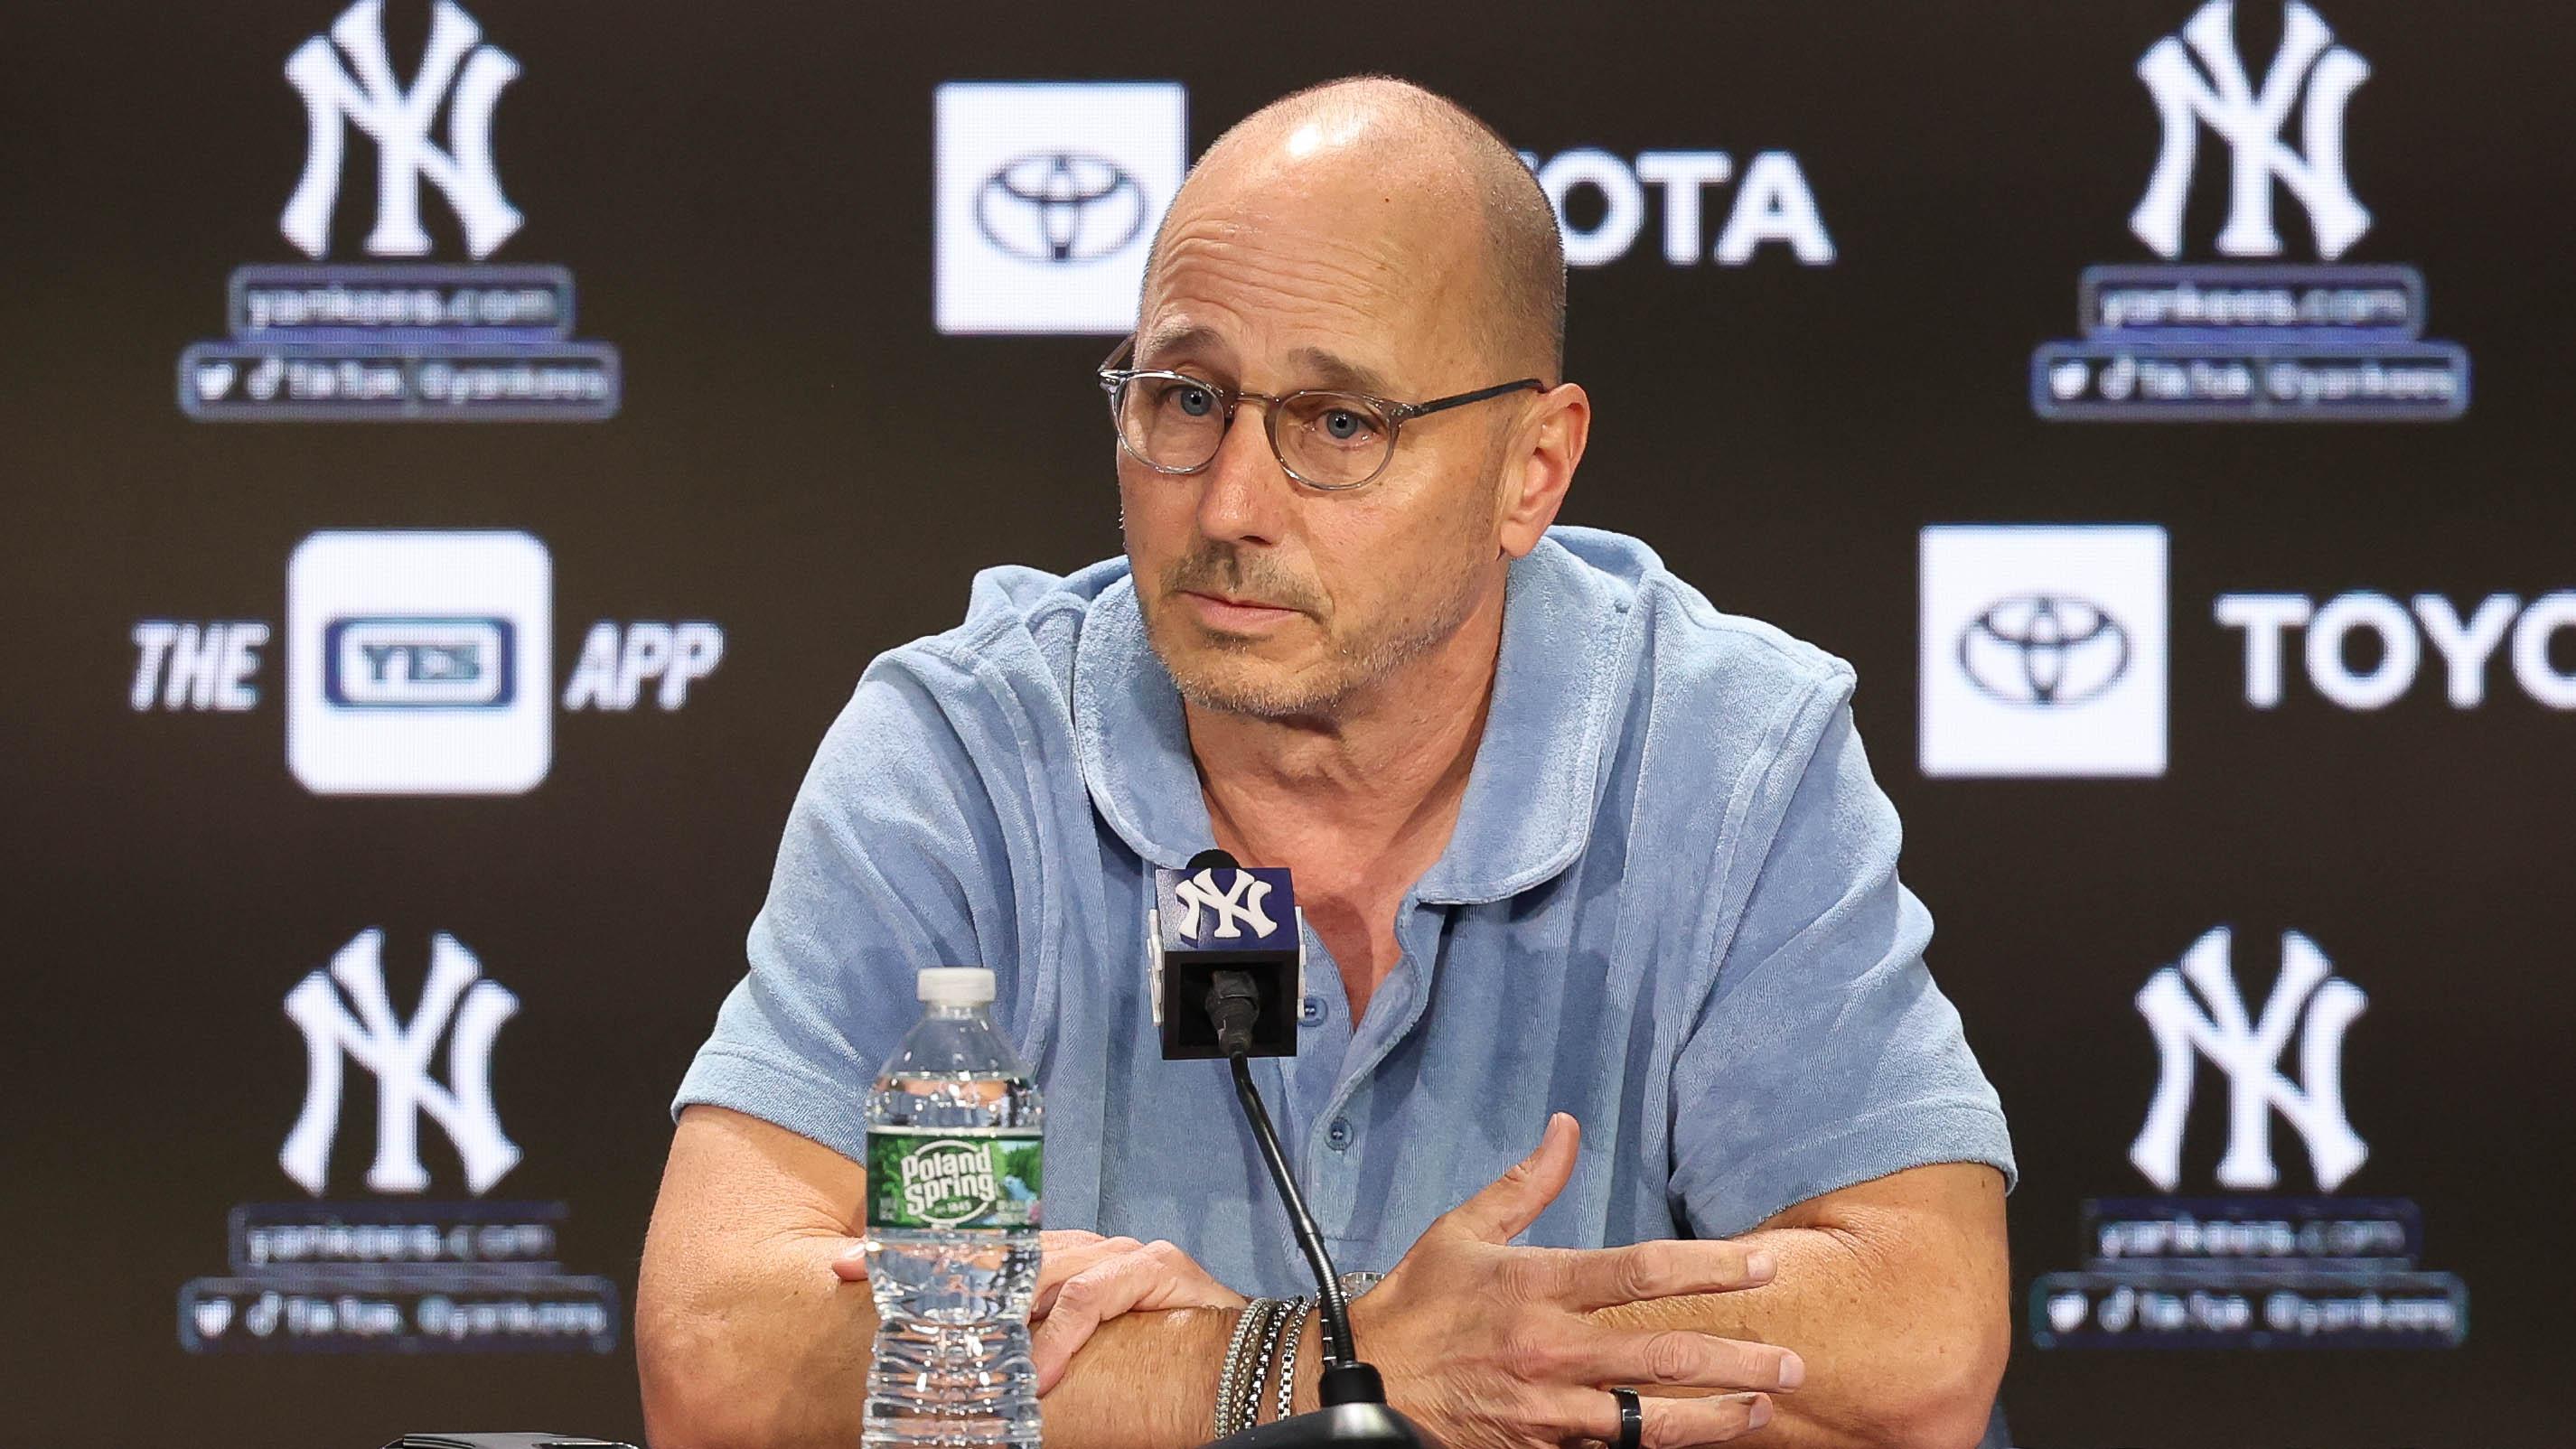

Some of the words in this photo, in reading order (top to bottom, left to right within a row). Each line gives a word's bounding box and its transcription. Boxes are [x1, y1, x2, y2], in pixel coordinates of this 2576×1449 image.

[280, 0, 525, 259] NY
[2128, 0, 2374, 259] NY
[1518, 147, 1838, 266] OTA
[131, 620, 270, 711] THE
[362, 644, 481, 679] YES
[562, 621, 724, 711] APP
[1176, 868, 1277, 940] NY
[280, 927, 523, 1197] NY
[2129, 926, 2368, 1192] NY
[901, 1142, 992, 1187] Poland
[904, 1174, 996, 1216] Spring
